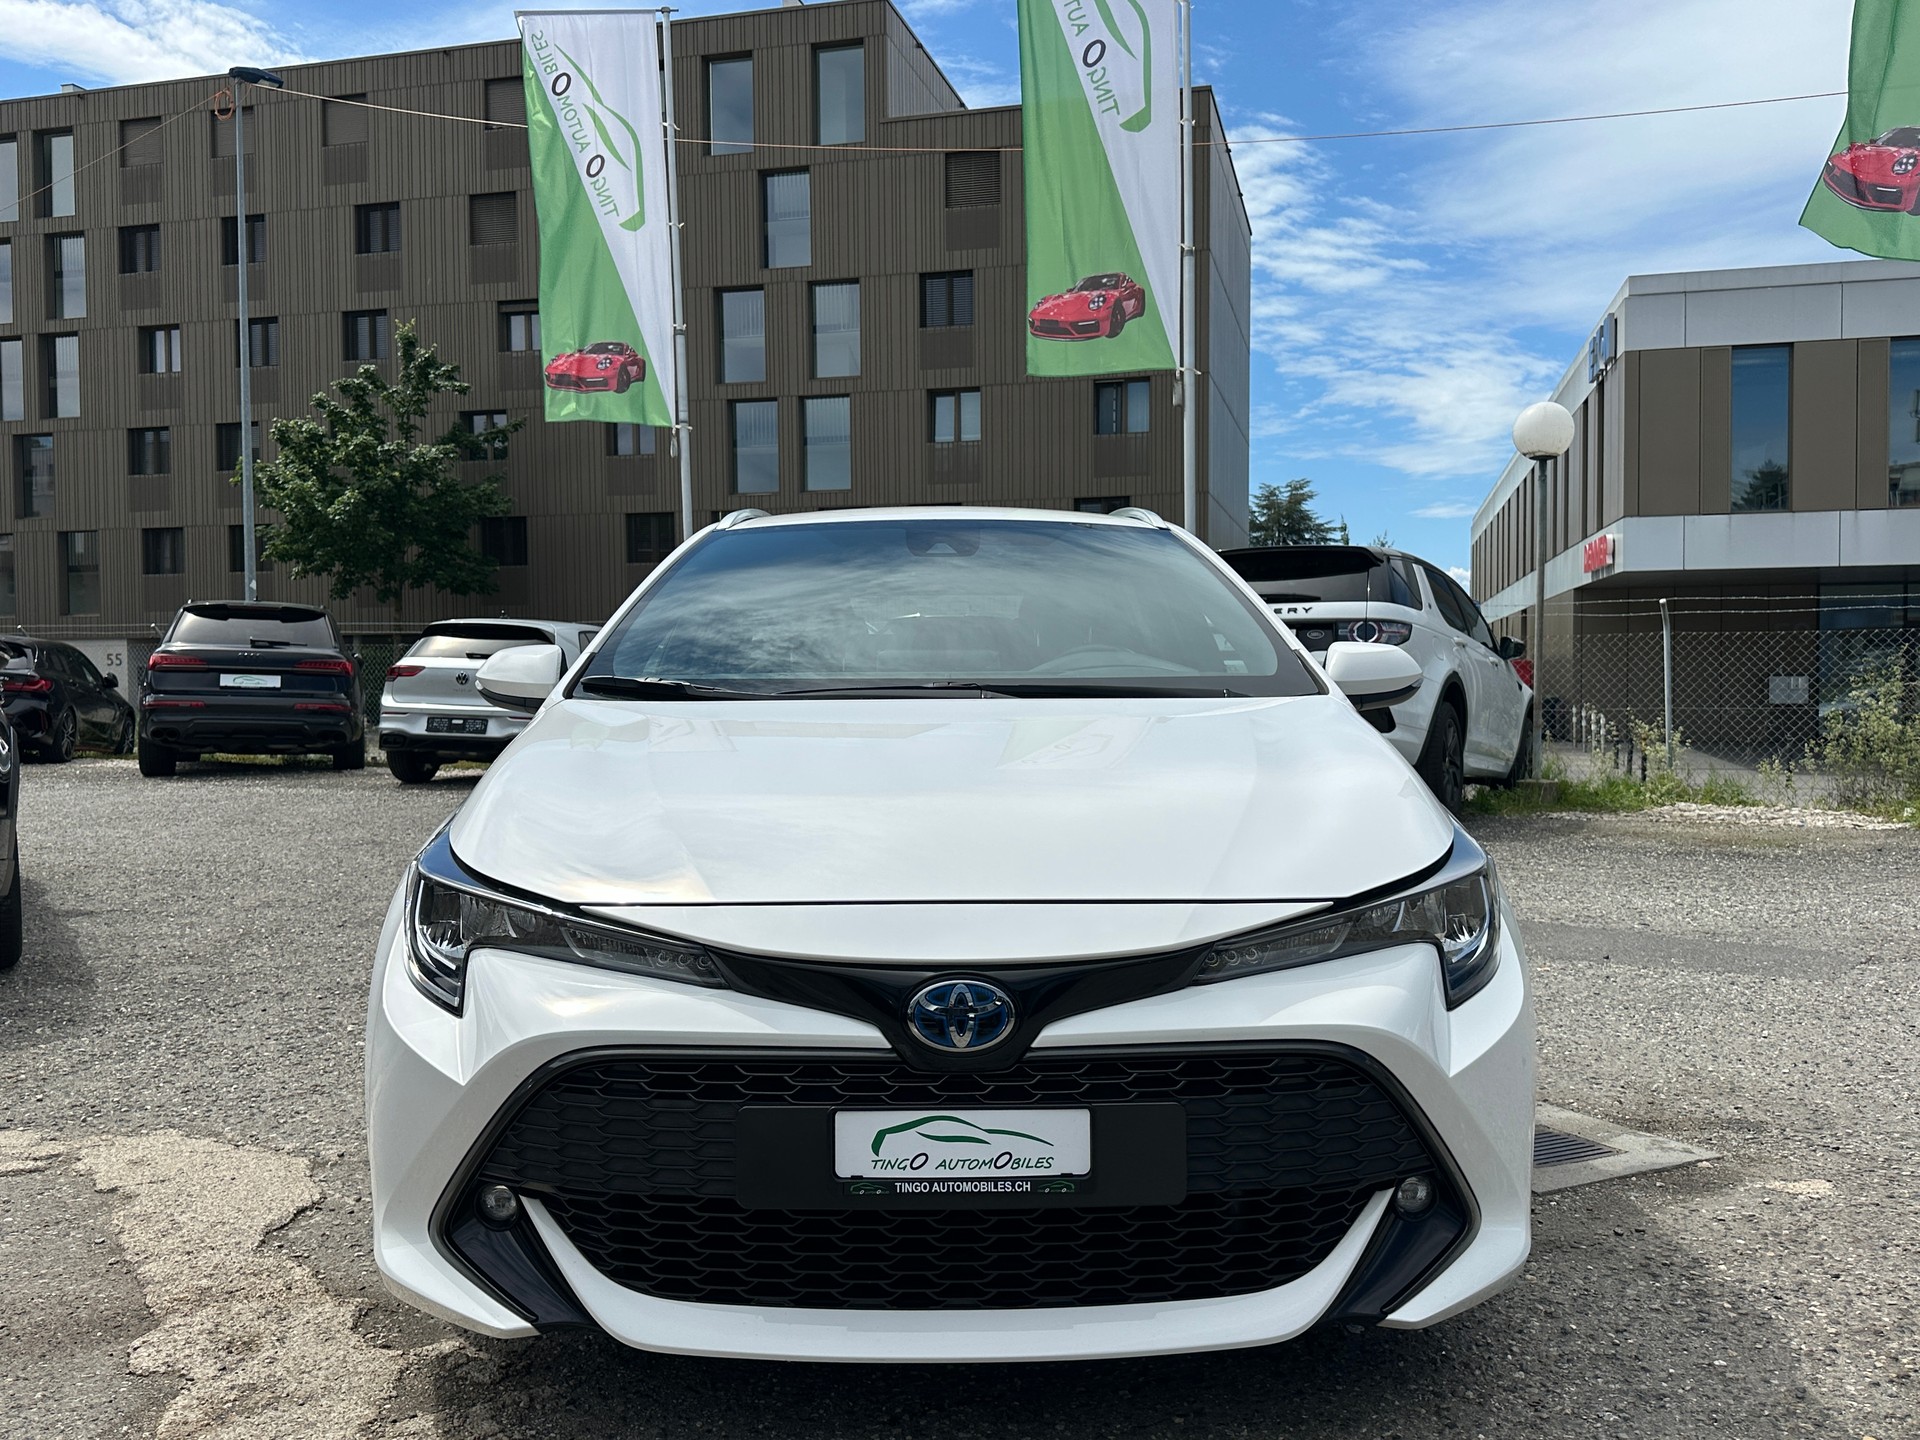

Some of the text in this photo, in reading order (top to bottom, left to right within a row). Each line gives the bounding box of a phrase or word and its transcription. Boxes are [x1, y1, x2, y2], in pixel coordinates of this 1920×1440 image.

[106, 653, 123, 667] 55
[871, 1151, 1055, 1171] TINGO AUTOMOBILES
[895, 1182, 930, 1194] TINGO
[931, 1181, 1031, 1194] AUTOMOBILES.CH
